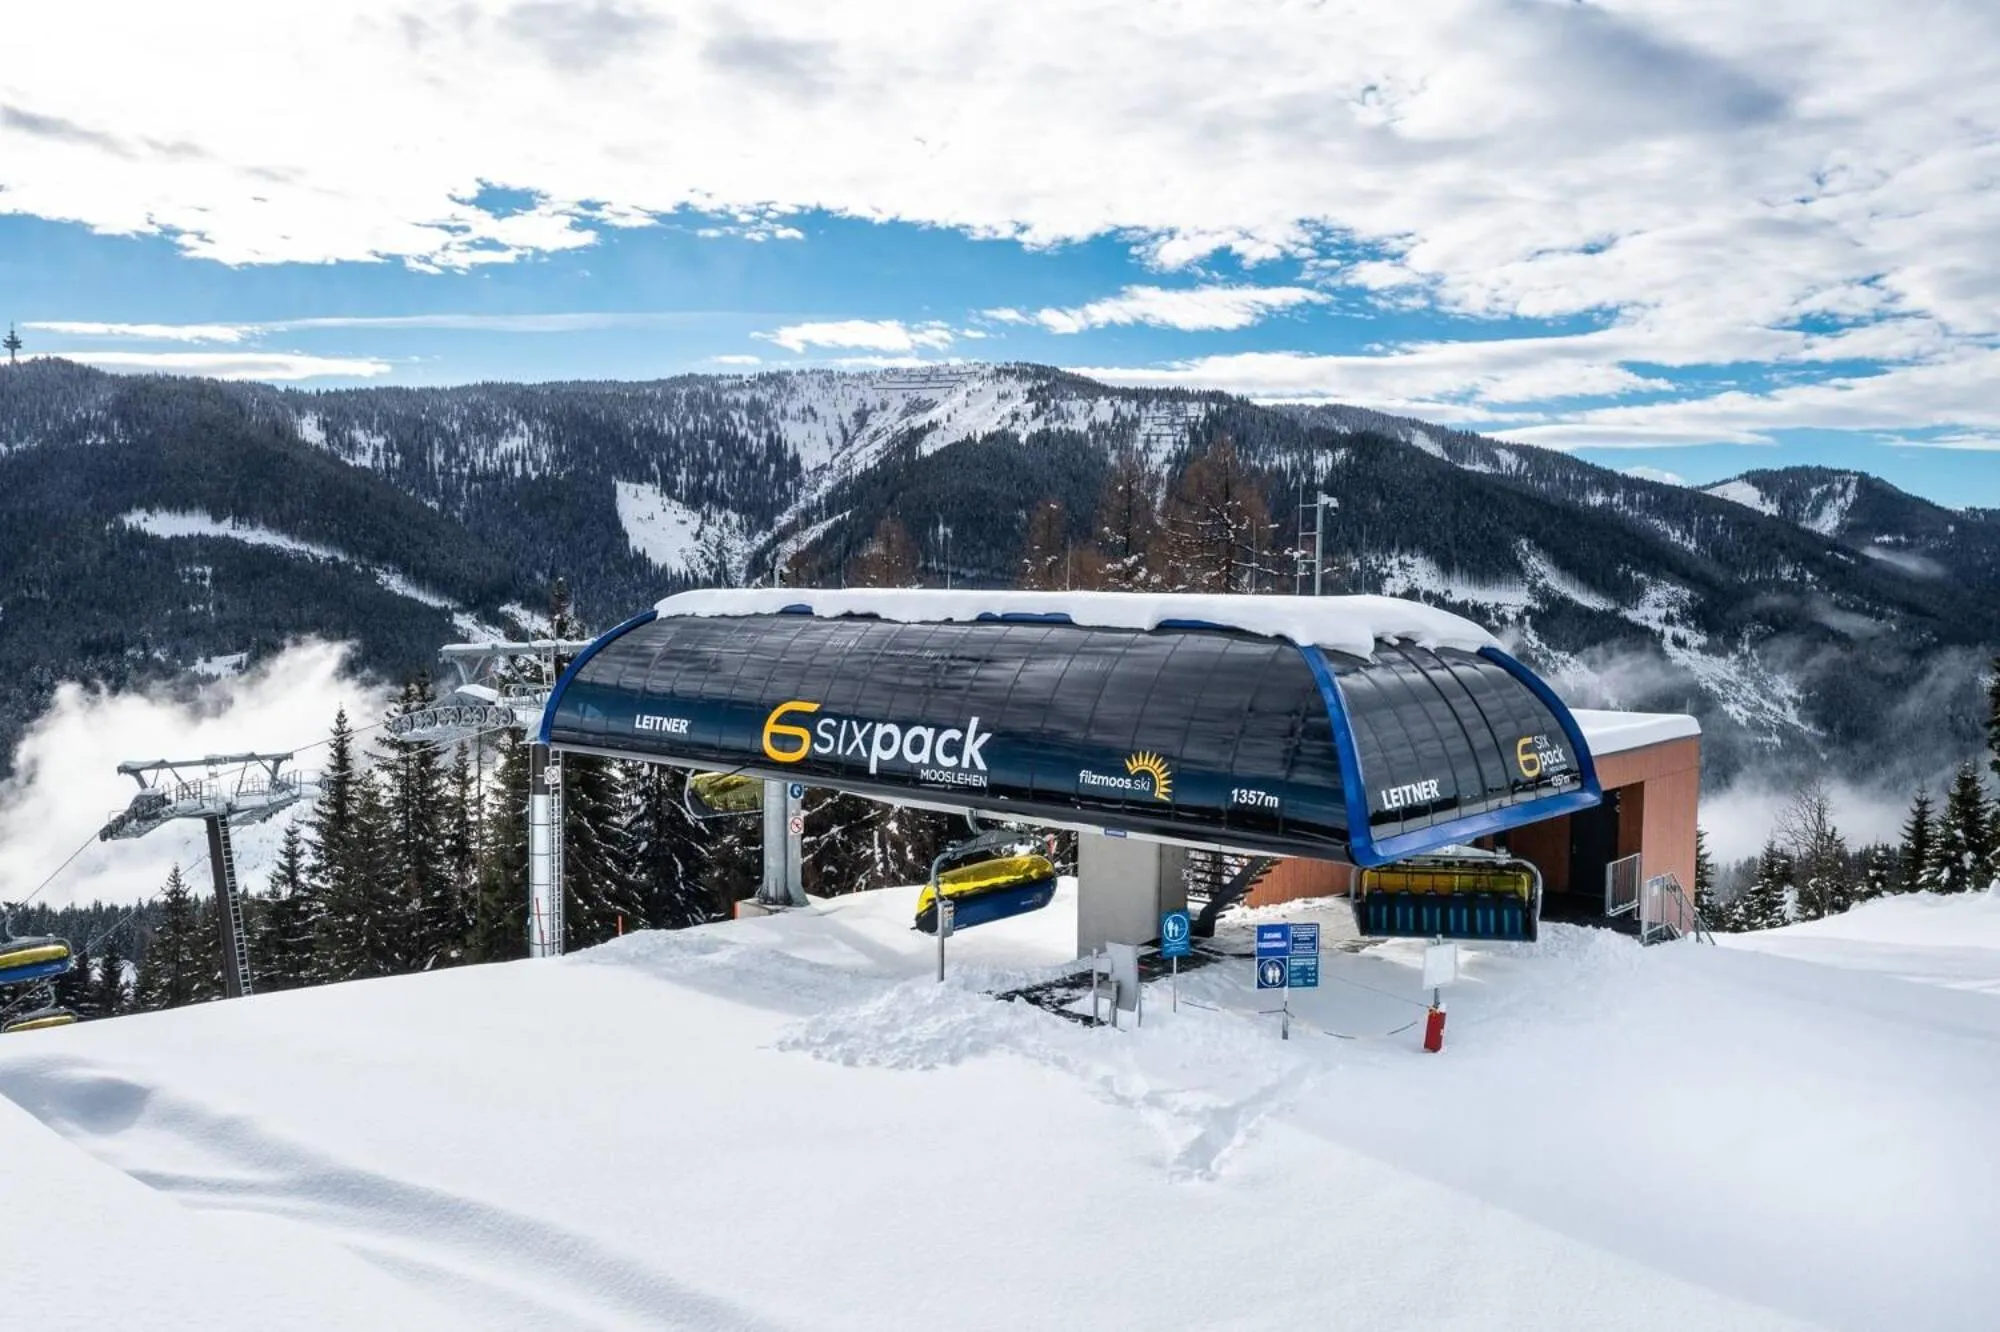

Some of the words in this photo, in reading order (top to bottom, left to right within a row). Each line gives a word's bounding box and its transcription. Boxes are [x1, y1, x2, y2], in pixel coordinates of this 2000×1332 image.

[635, 714, 689, 734] LEITNER
[762, 700, 821, 763] 6
[1516, 736, 1541, 777] 6
[1539, 744, 1566, 772] pack
[920, 768, 988, 788] MOOSLEHEN
[1079, 769, 1151, 791] filzmoos.ski
[1231, 787, 1279, 808] 1357m
[1381, 778, 1440, 810] LEITNER
